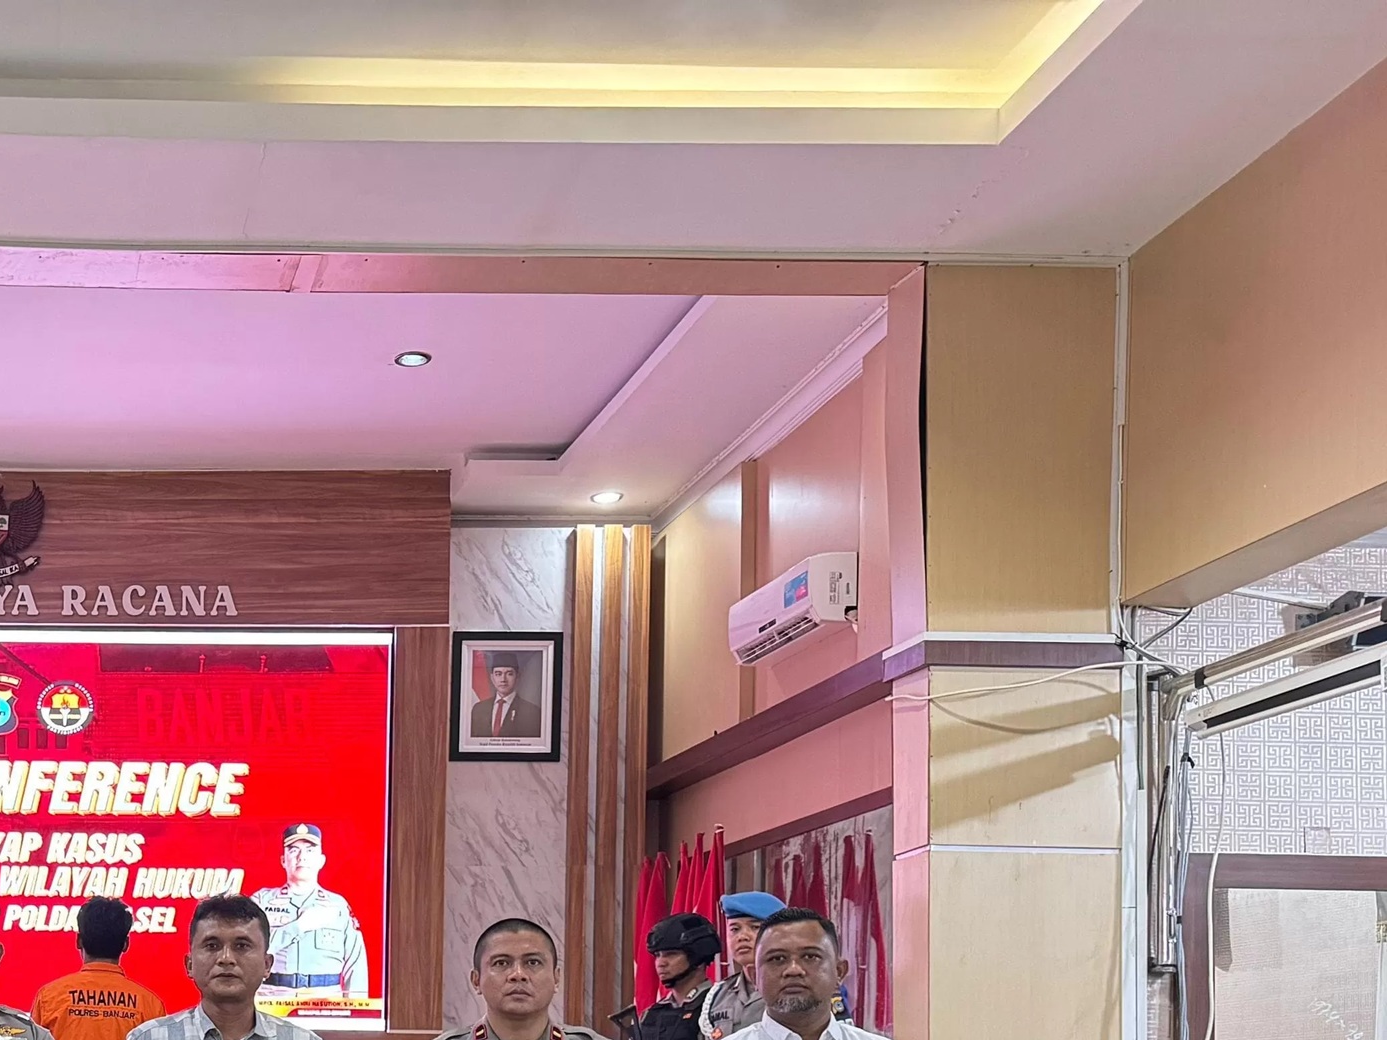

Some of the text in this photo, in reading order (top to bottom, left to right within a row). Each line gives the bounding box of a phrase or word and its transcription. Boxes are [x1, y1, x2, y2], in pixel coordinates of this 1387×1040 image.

[60, 585, 239, 617] RACANA
[136, 687, 312, 745] BANJAR
[46, 832, 145, 864] KASUS
[132, 867, 245, 899] HUKUM
[68, 988, 137, 1009] TAHANAN
[68, 1008, 135, 1020] POLRES BANJAR
